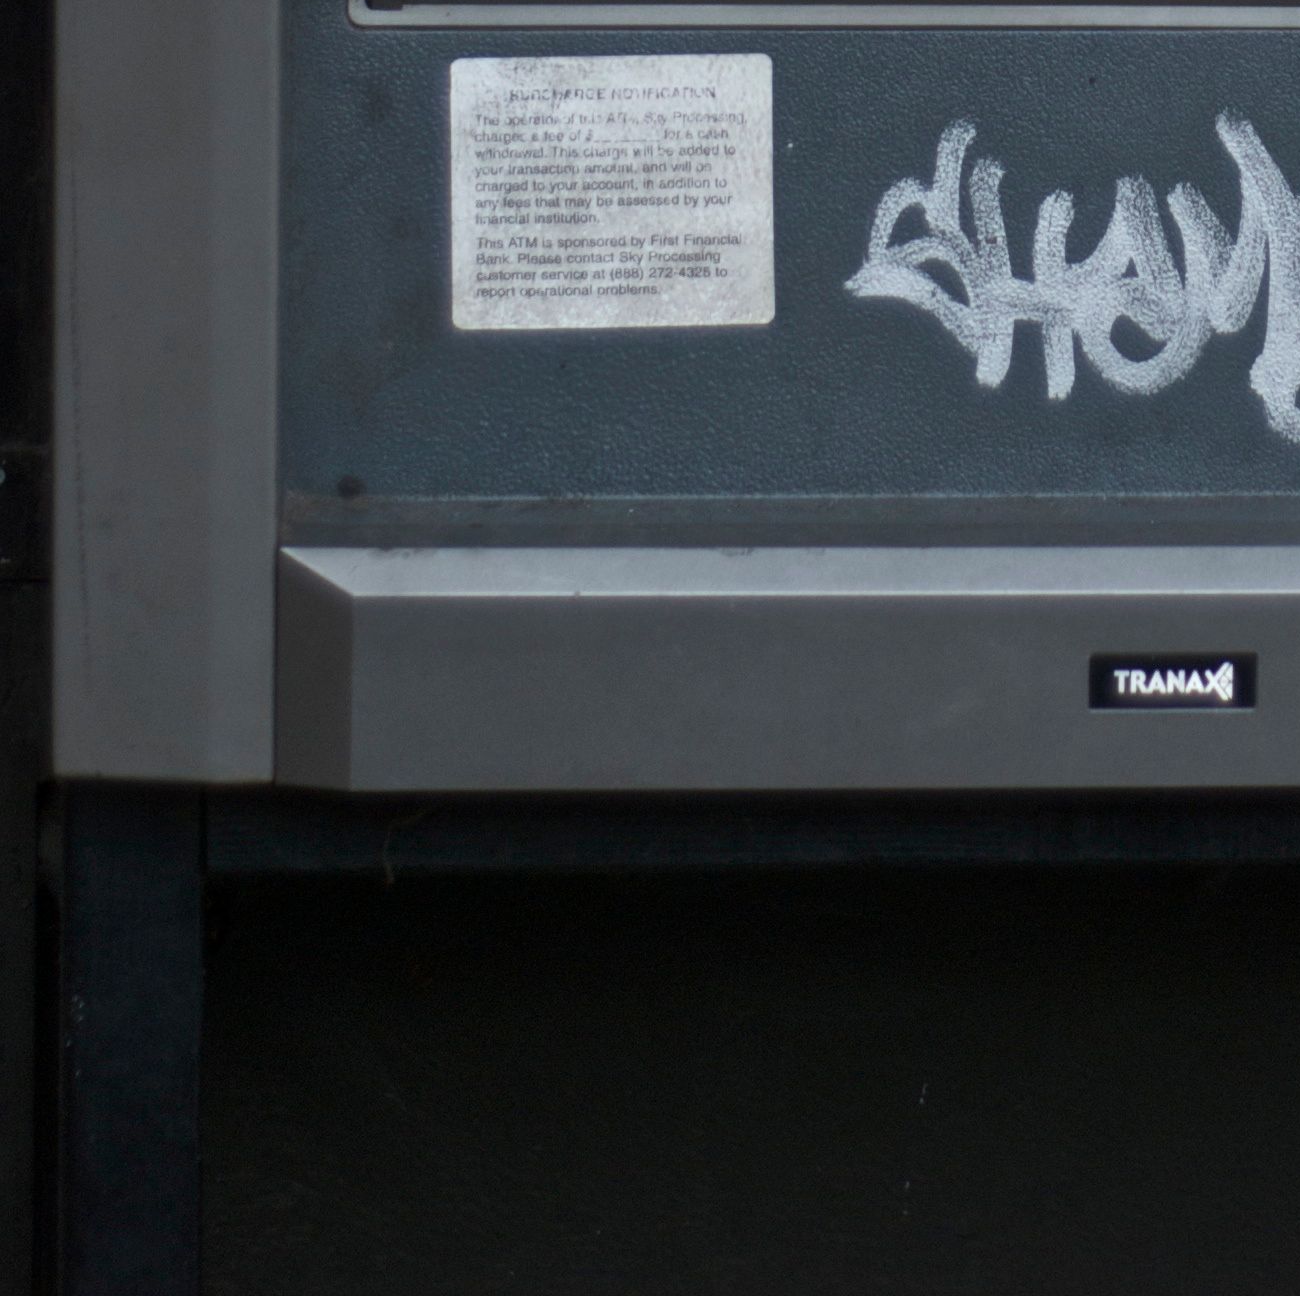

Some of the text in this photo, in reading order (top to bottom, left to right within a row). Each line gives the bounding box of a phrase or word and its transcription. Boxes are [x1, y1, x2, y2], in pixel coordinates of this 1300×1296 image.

[550, 146, 579, 158] This
[633, 145, 653, 157] will
[679, 144, 719, 157] added
[724, 144, 736, 156] to
[475, 166, 502, 178] your
[642, 162, 667, 174] and
[671, 161, 692, 172] will
[475, 180, 528, 194] charged
[533, 181, 545, 192] to
[549, 181, 578, 194] your
[643, 178, 654, 189] in
[658, 177, 710, 189] addition
[715, 178, 727, 188] to
[475, 194, 733, 211] any fees that may be assessed by your
[477, 233, 742, 250] This ATM is sponsored by First Financial
[517, 253, 562, 265] Please
[566, 252, 614, 264] contact
[619, 251, 643, 265] Sky
[648, 250, 721, 264] Processing
[476, 271, 537, 282] customer
[541, 269, 588, 281] service
[592, 269, 606, 280] at
[609, 267, 644, 281] (888)
[715, 267, 728, 278] to
[475, 286, 516, 299] report
[519, 286, 593, 299] operational
[1113, 661, 1234, 701] TRANAX
